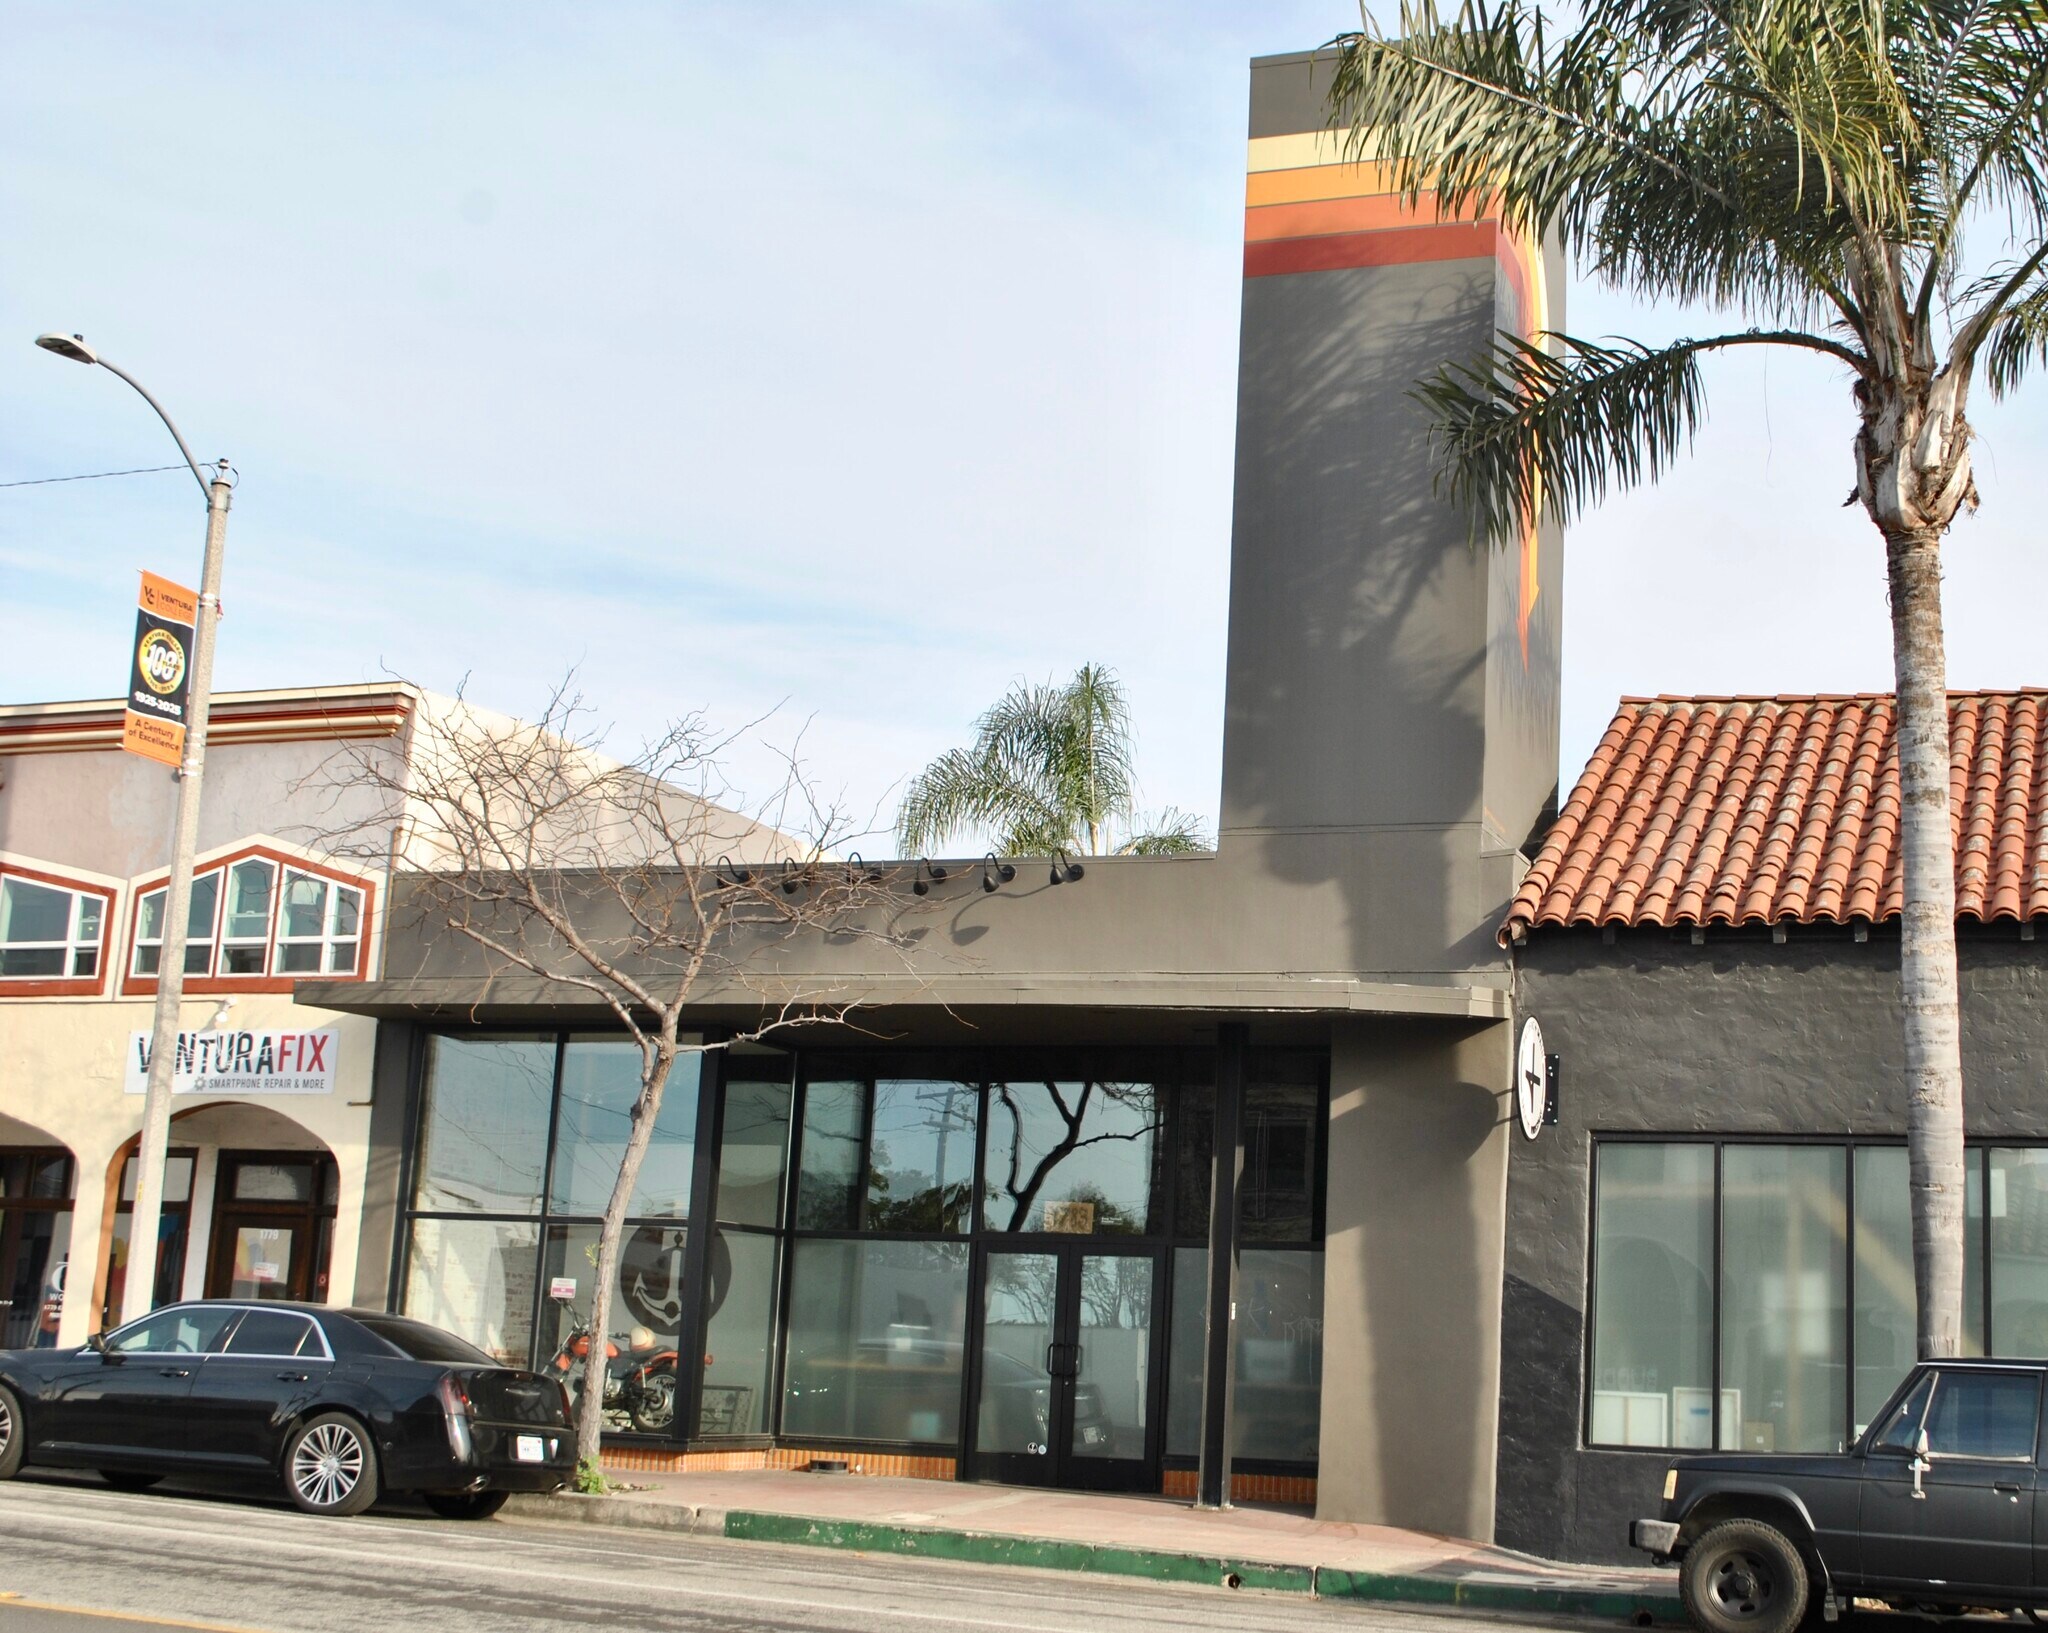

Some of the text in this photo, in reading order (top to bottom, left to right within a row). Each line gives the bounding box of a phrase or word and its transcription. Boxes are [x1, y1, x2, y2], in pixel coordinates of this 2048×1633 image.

[161, 593, 193, 612] VENTURA
[134, 691, 182, 716] 1925-2025
[135, 719, 175, 739] A Century
[138, 732, 180, 751] Excellence
[139, 1031, 329, 1075] VNTURAFIX
[209, 1079, 325, 1089] SMARTPHONE REPAIR & MORE
[260, 1230, 279, 1240] 1779
